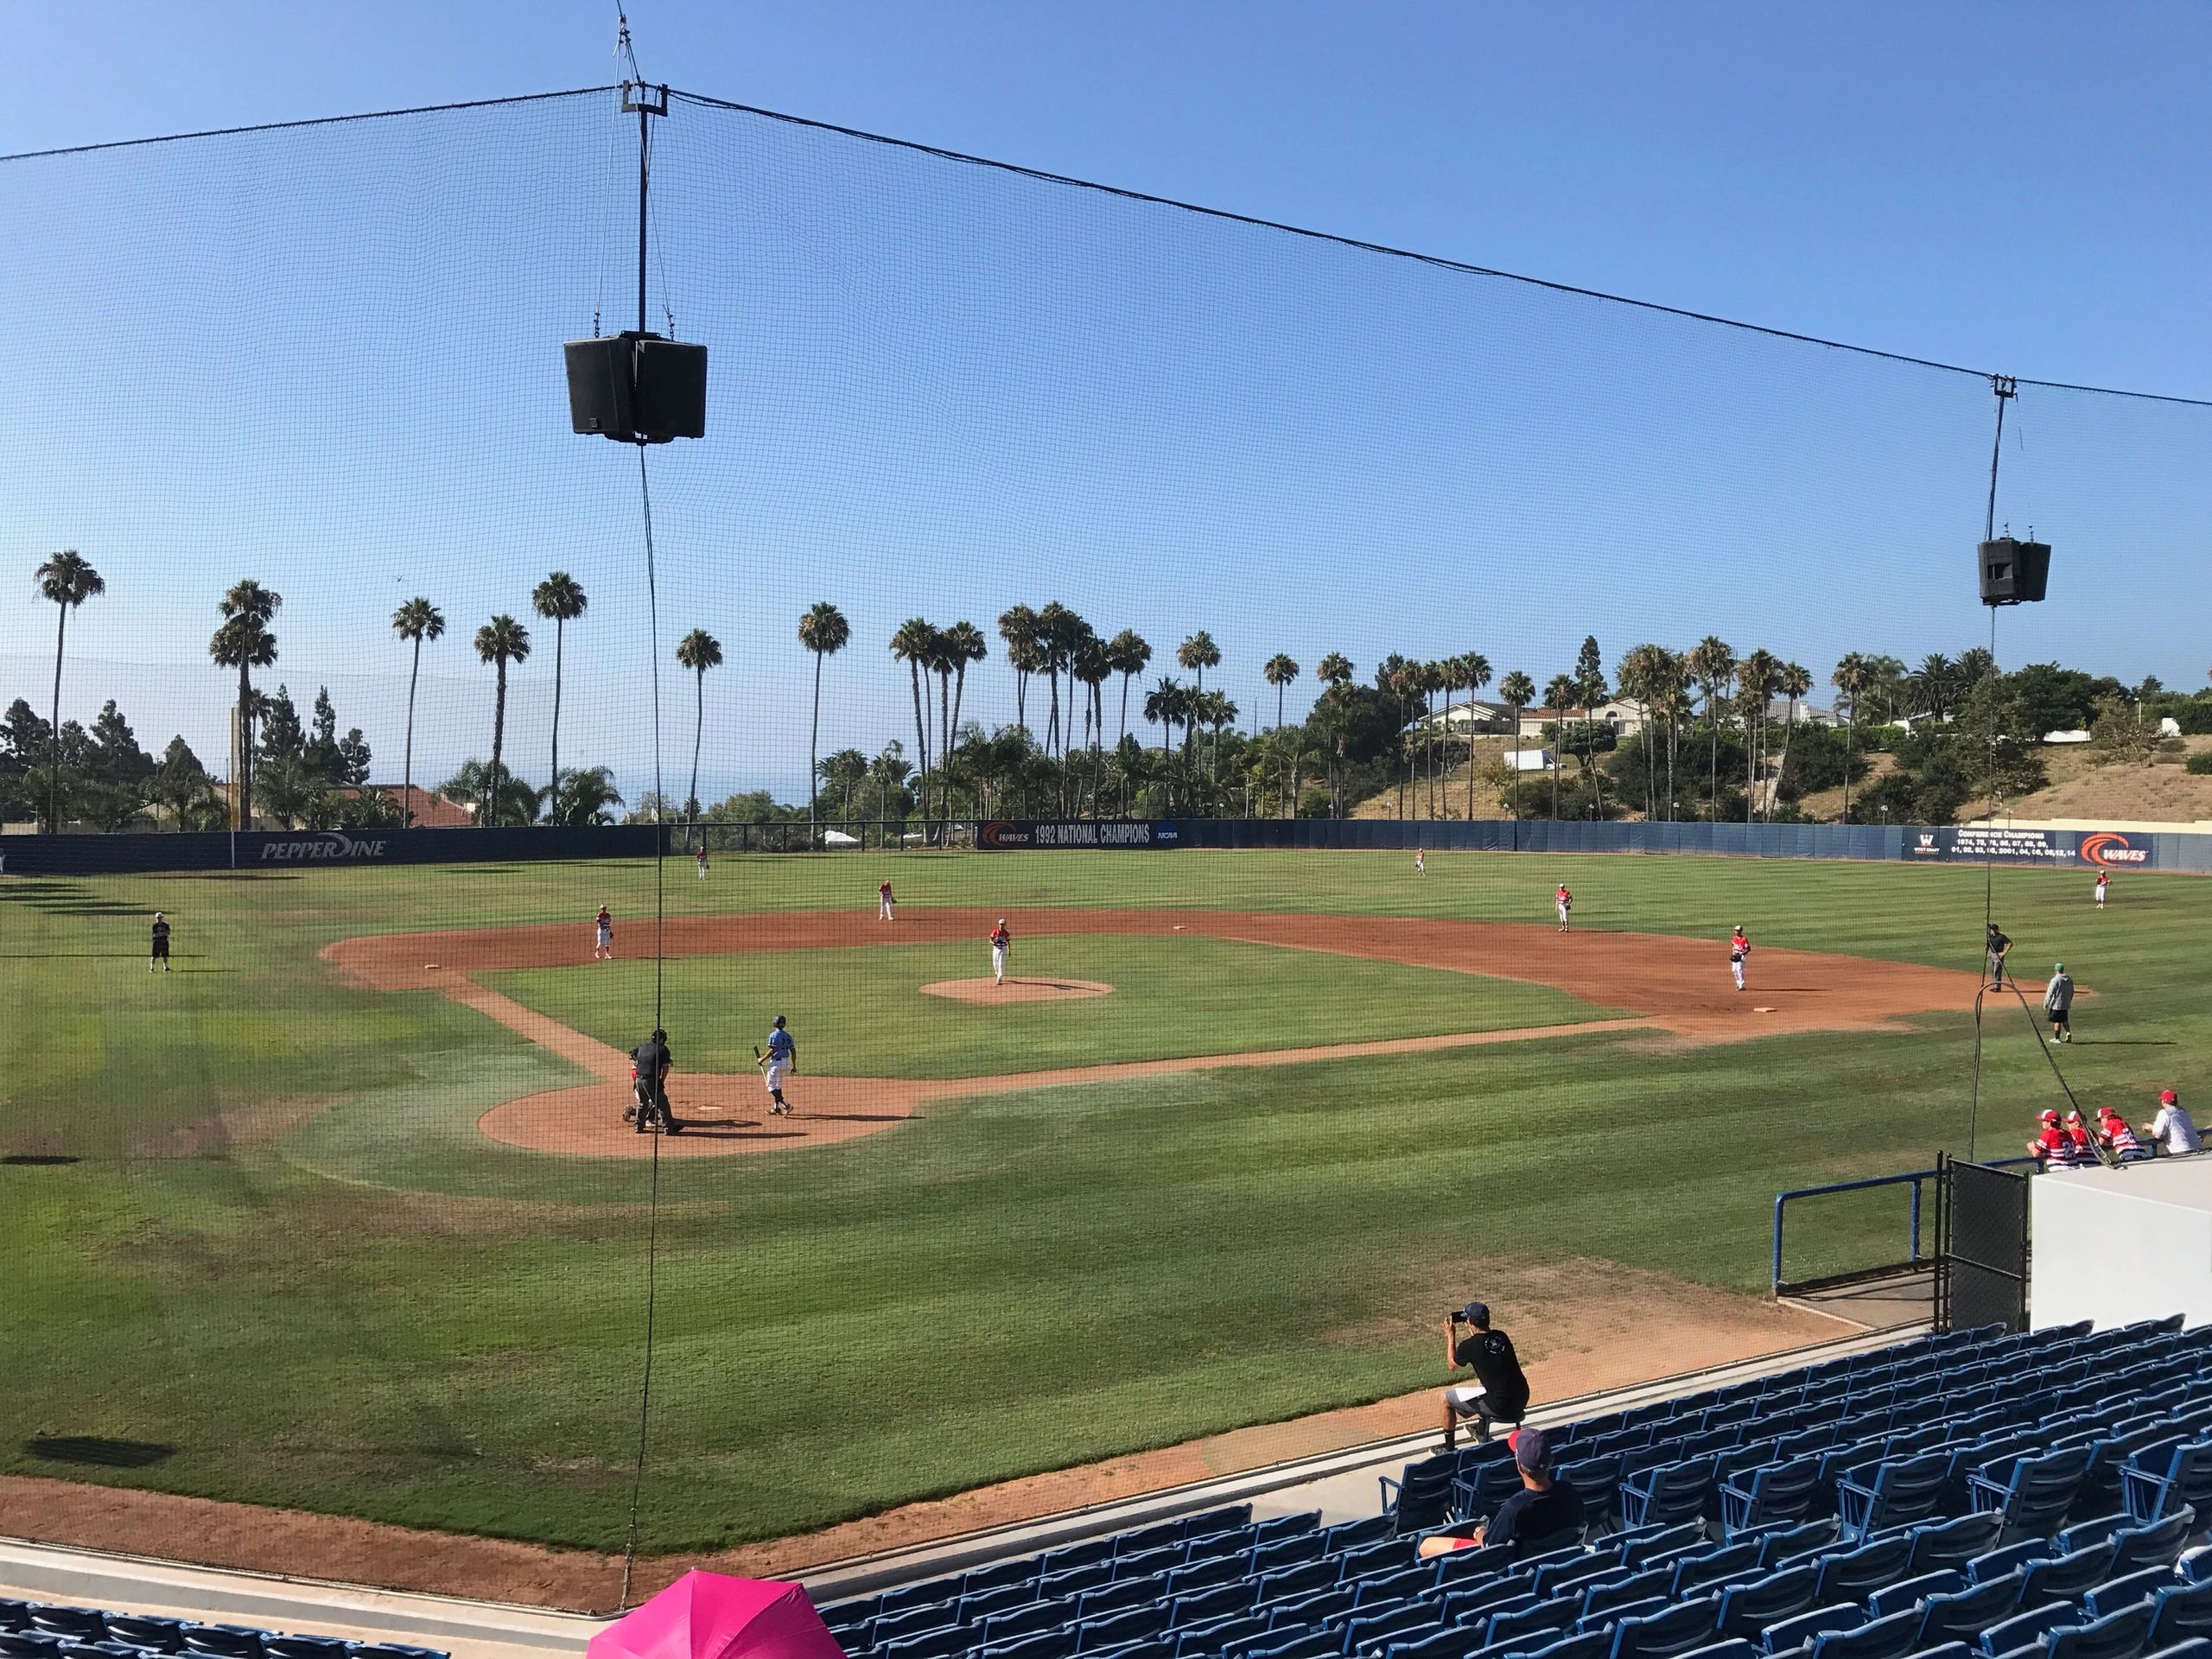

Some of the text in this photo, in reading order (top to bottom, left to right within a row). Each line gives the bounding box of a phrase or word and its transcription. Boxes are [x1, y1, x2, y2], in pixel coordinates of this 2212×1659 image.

[998, 833, 1030, 842] WAVES
[1035, 823, 1150, 844] 1992 NATIONAL CHAMPIONS
[261, 832, 387, 860] PEPPERDINE
[2103, 849, 2146, 861] WAVES
